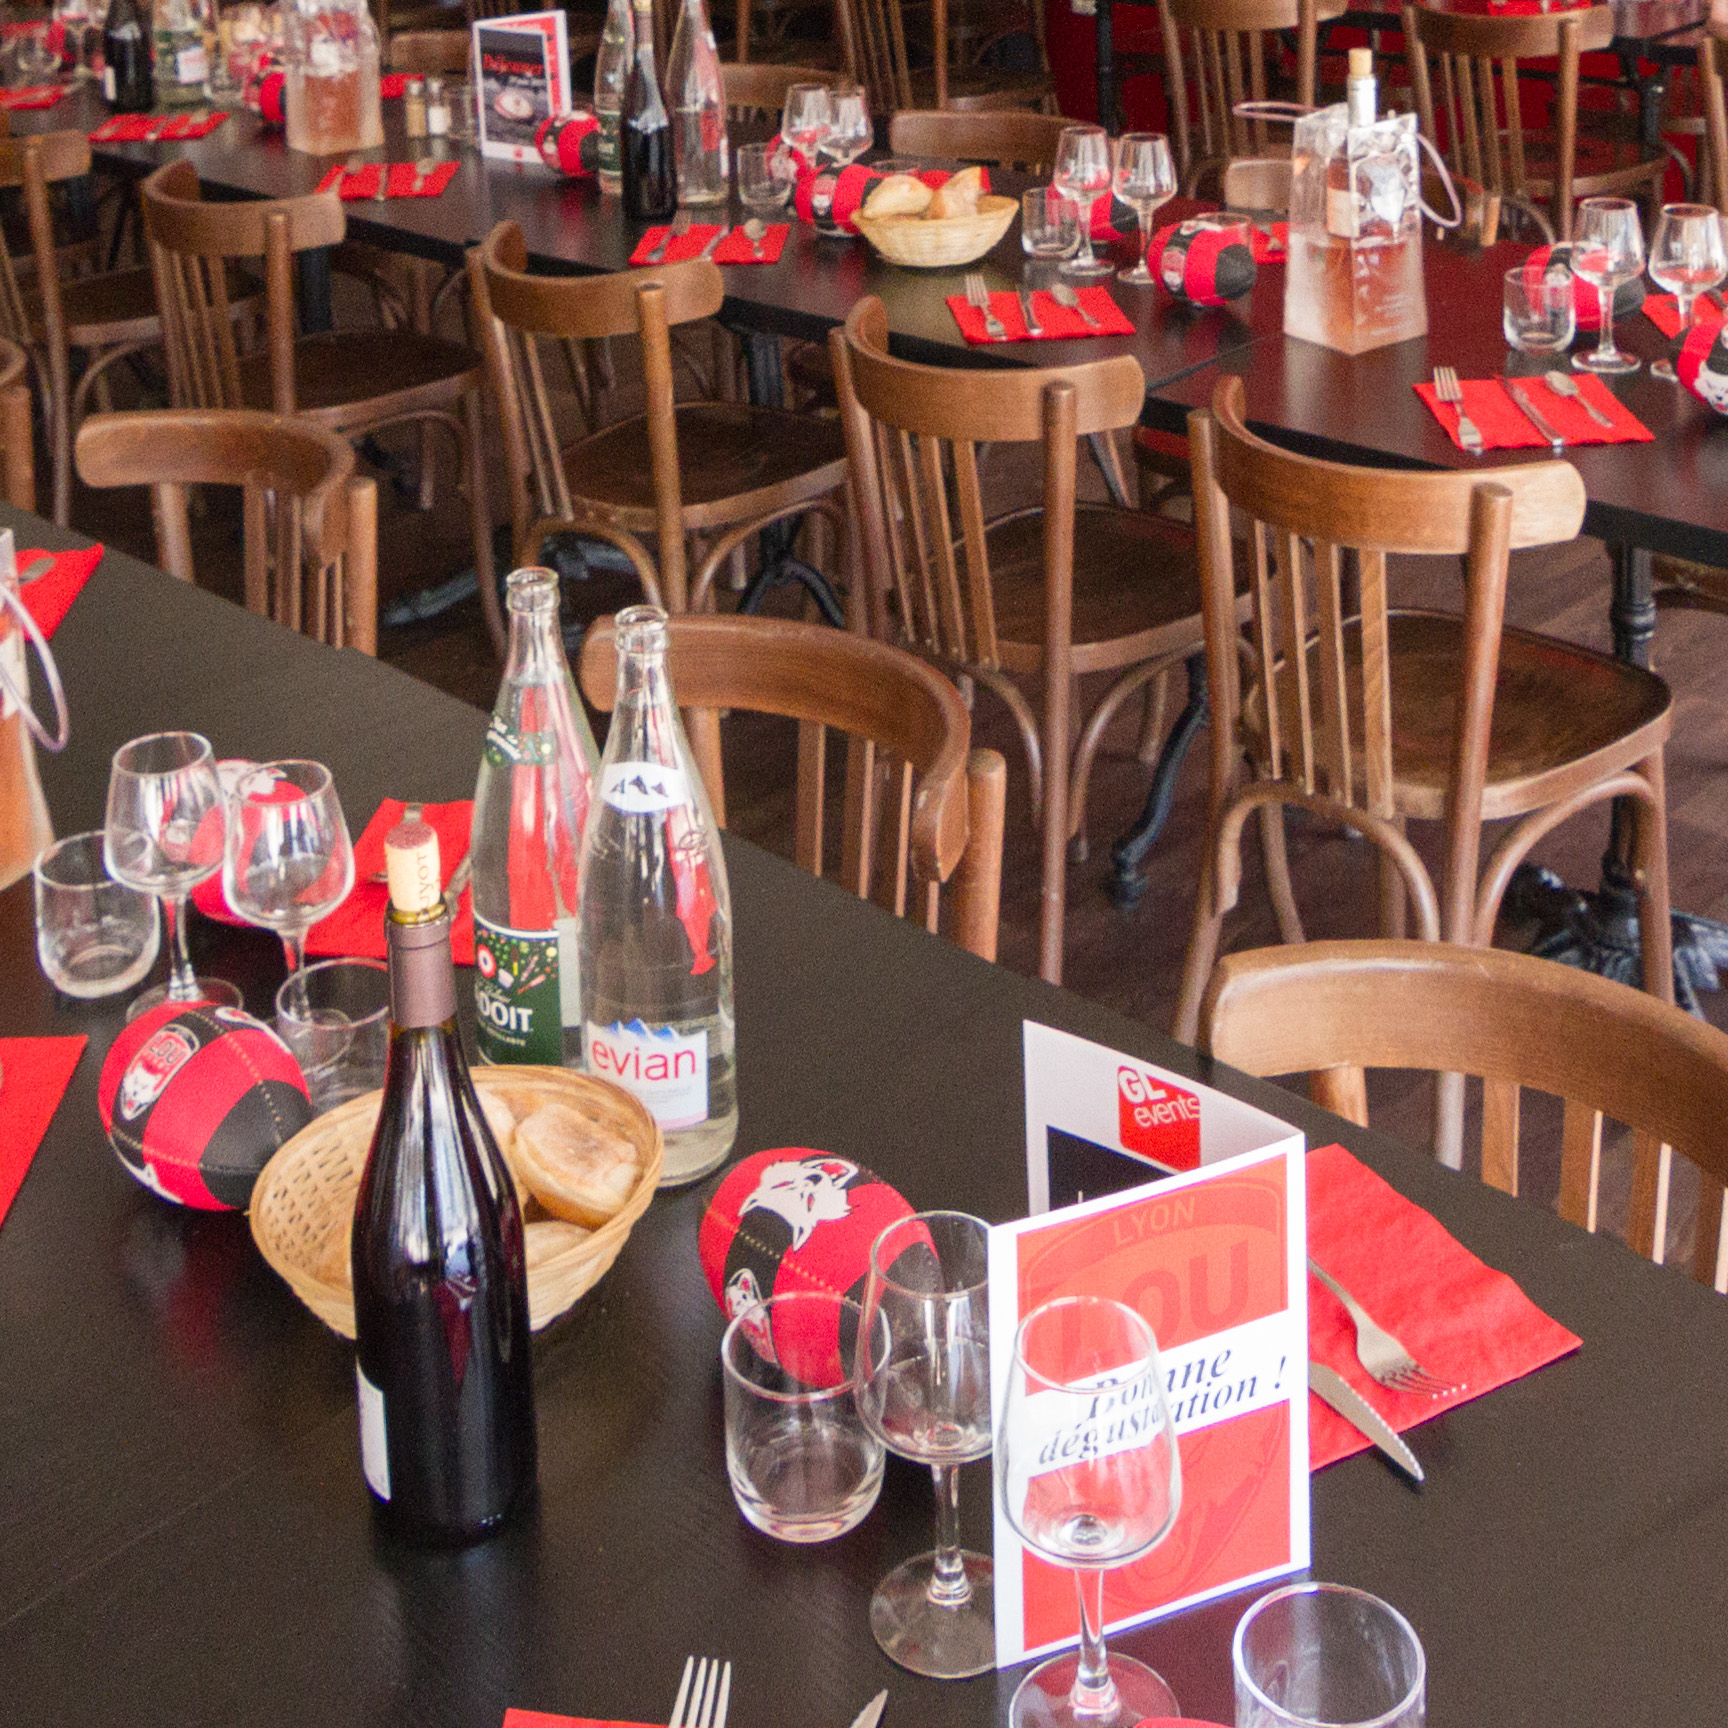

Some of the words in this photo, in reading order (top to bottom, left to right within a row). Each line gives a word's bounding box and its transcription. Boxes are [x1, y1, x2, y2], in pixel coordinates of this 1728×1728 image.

[475, 990, 533, 1032] DOIT
[591, 1039, 697, 1081] evian
[1118, 1070, 1168, 1104] GL
[1133, 1093, 1200, 1128] events
[1114, 1196, 1195, 1246] LYON
